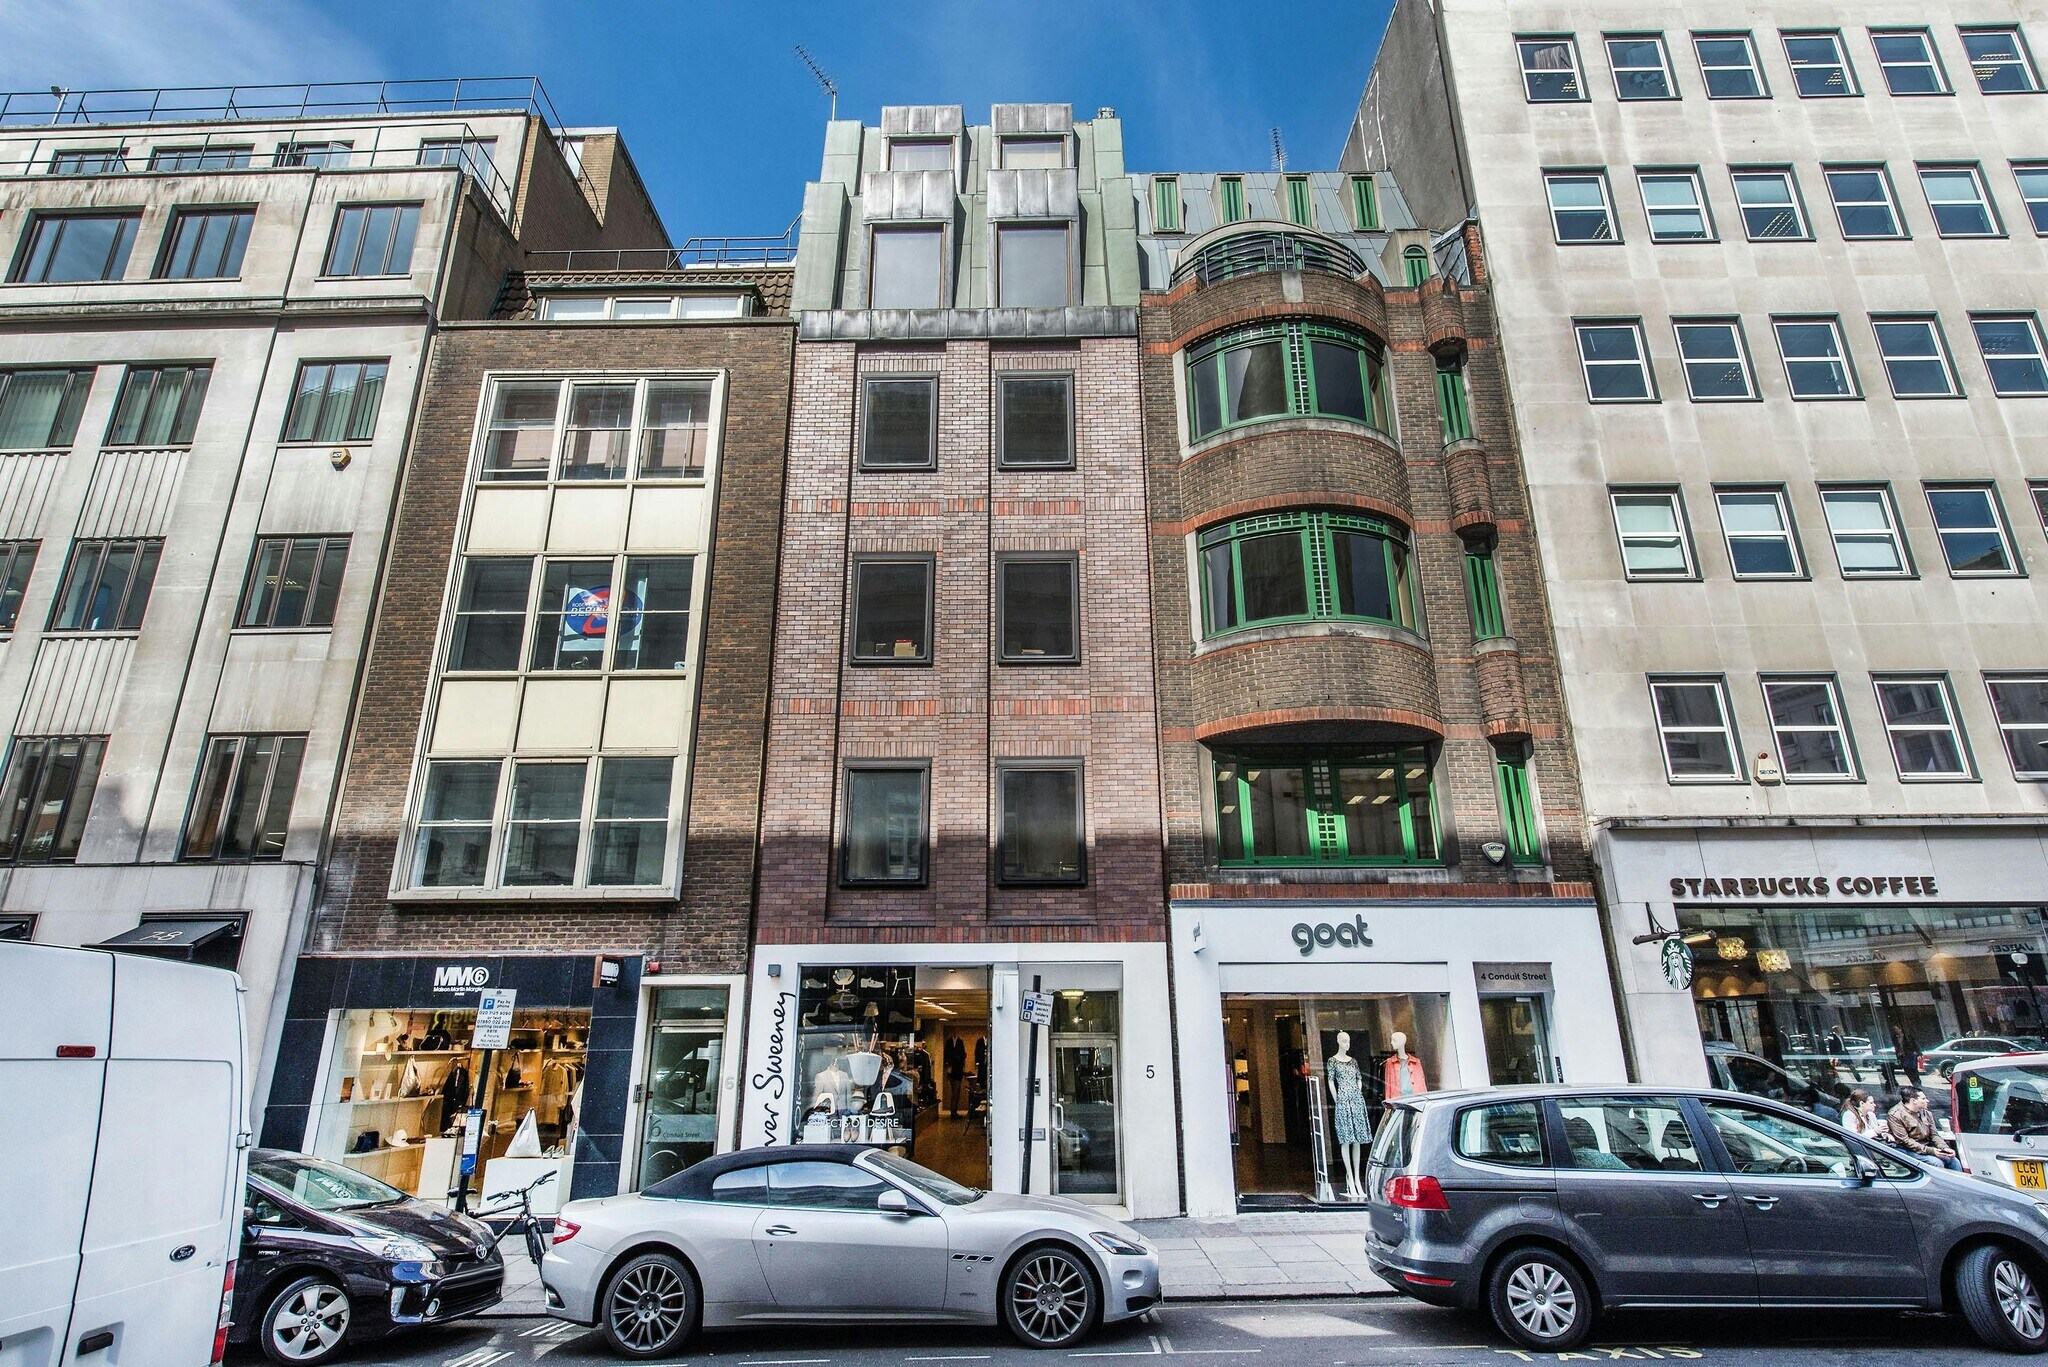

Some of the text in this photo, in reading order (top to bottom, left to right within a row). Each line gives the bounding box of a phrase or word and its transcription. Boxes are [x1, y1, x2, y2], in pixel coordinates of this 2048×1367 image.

[1670, 876, 1939, 897] STARBUCKS COFFEE
[1291, 913, 1374, 954] goat
[433, 966, 490, 987] MM6
[1480, 972, 1547, 981] 4 Conduit Street
[485, 1000, 494, 1009] P
[1025, 1000, 1033, 1010] P
[752, 991, 796, 1147] ver Sweeney
[1146, 1064, 1155, 1079] 5
[725, 1076, 736, 1090] 6
[651, 1118, 662, 1138] 6
[867, 1118, 899, 1128] DESIRE
[2016, 1161, 2039, 1174] LC61
[2020, 1174, 2041, 1187] OKX
[1493, 1347, 1704, 1362] TAXIS
